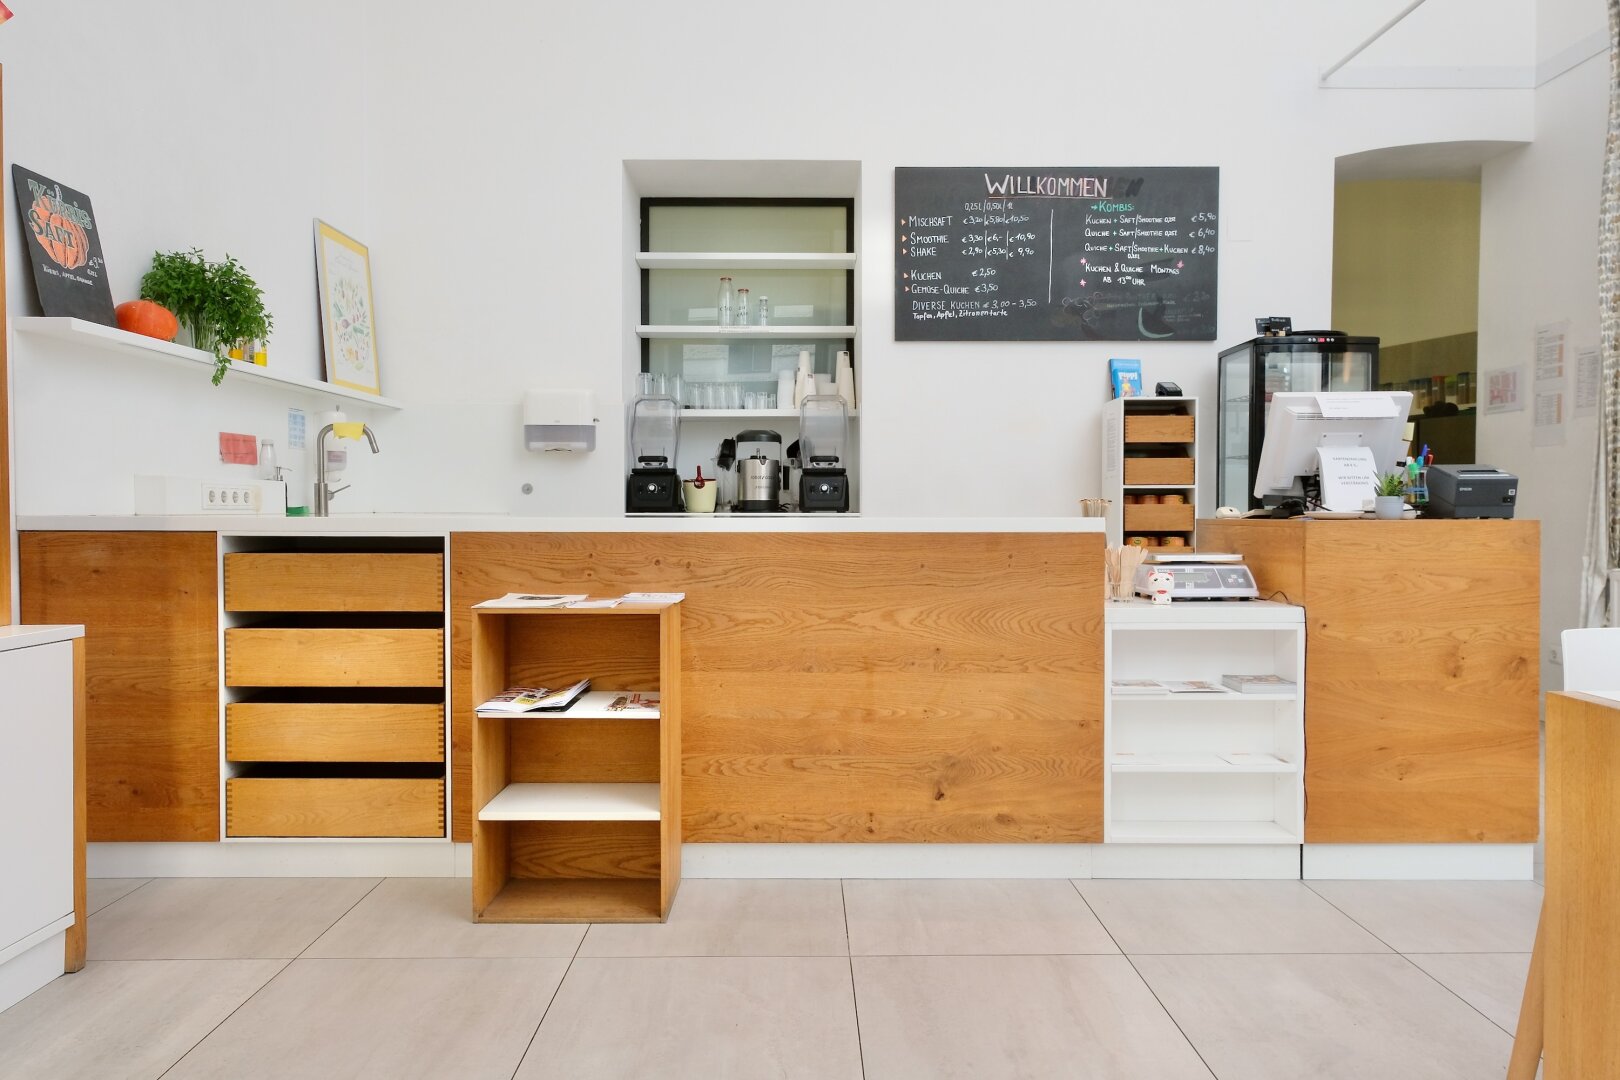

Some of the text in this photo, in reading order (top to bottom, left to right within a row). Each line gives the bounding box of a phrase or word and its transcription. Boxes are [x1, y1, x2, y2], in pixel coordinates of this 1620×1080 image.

[984, 173, 1108, 198] WILLKOMMEN
[908, 215, 953, 227] MISCHSAFT
[1085, 214, 1112, 225] KUCHEN
[28, 208, 75, 249] SAFT
[1084, 227, 1110, 238] QUICHE
[910, 231, 950, 245] SMOOTHIE
[910, 246, 937, 258] SHAKE
[1084, 242, 1108, 252] QUICHE
[1163, 243, 1189, 254] KUCHEN
[1085, 262, 1180, 275] KUCHEN & QUICHE MONTAGS
[910, 269, 942, 281] KUCHEN
[1102, 276, 1112, 284] AB
[1132, 278, 1146, 287] UHR
[911, 283, 970, 295] GEMÜSE-QUICHE
[912, 300, 946, 311] DIVERSE
[950, 300, 981, 310] KUCHEN
